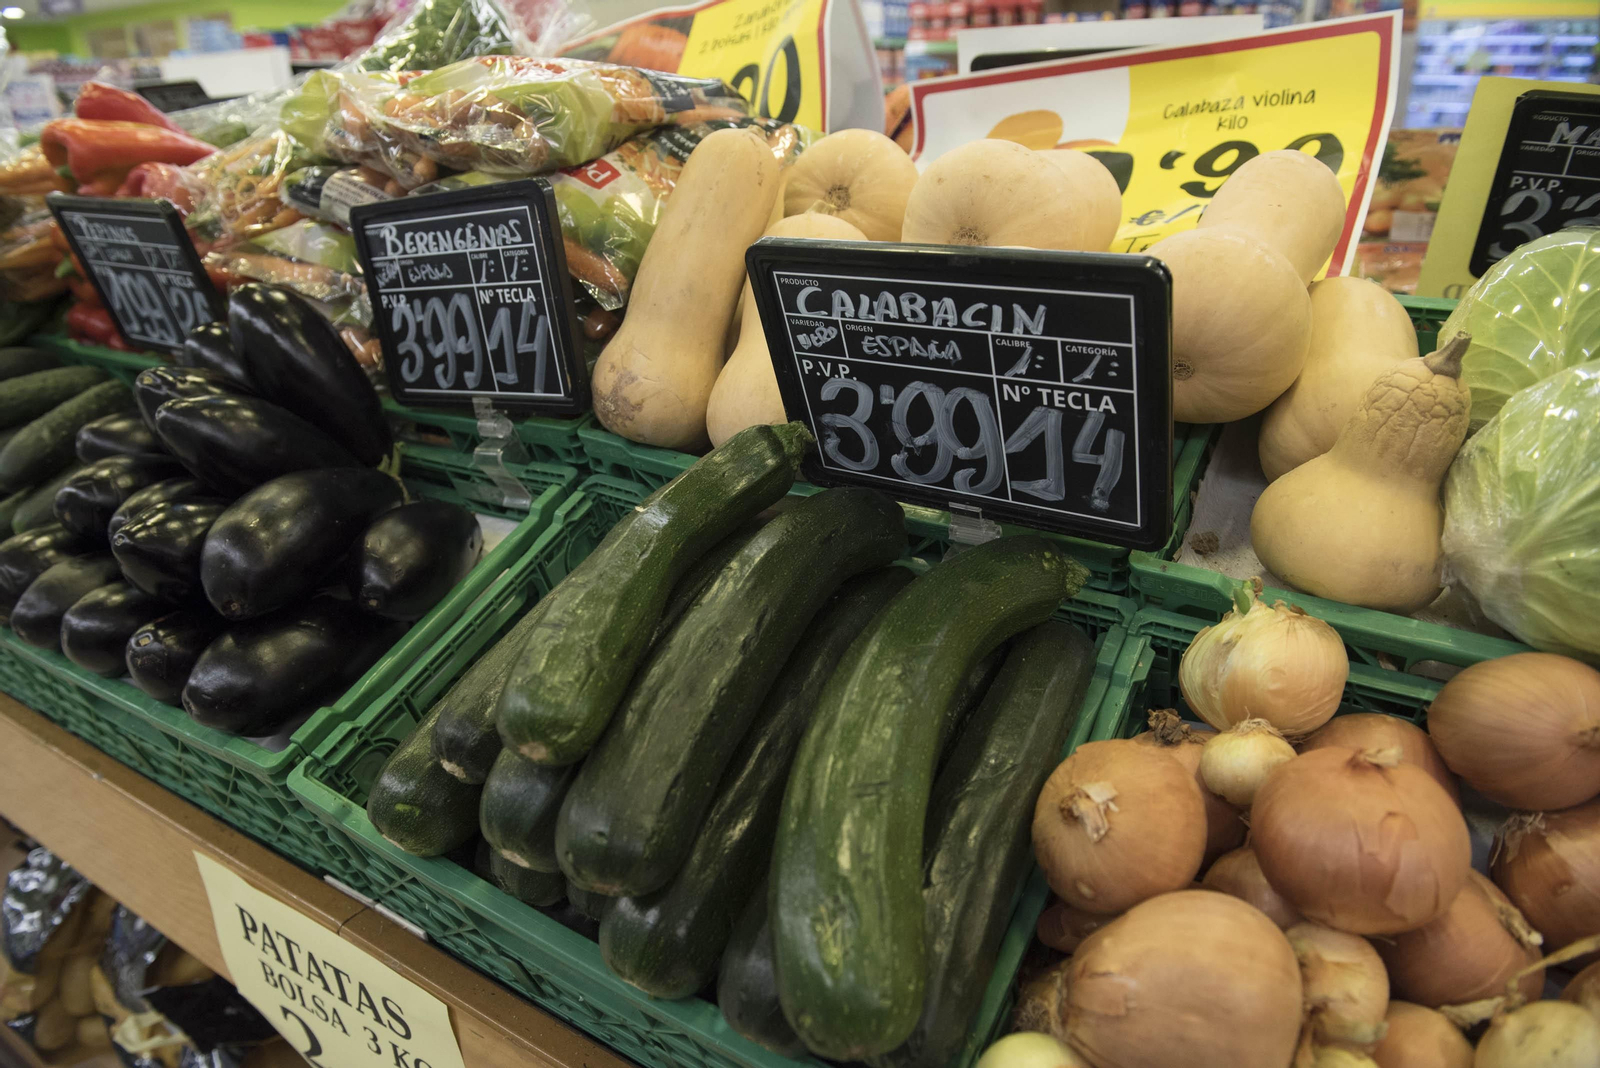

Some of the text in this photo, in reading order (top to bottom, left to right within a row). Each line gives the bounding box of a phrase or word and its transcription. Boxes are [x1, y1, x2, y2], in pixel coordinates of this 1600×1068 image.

[1163, 89, 1316, 119] Calabaza violina
[1216, 115, 1249, 131] kilo
[1509, 175, 1564, 193] P.V.P.
[780, 277, 819, 287] PRODUCTO
[495, 287, 536, 303] TECLA
[796, 286, 1047, 336] CALABACIN
[790, 318, 874, 333] VARIEDAD ORIGEN
[995, 338, 1118, 357] CALIBRE CATEGORÍA
[802, 359, 858, 381] P.V.P.
[1036, 386, 1117, 415] TECLA
[235, 903, 412, 1040] PATATAS
[258, 958, 350, 1037] BOLSA
[363, 1026, 382, 1055] 3
